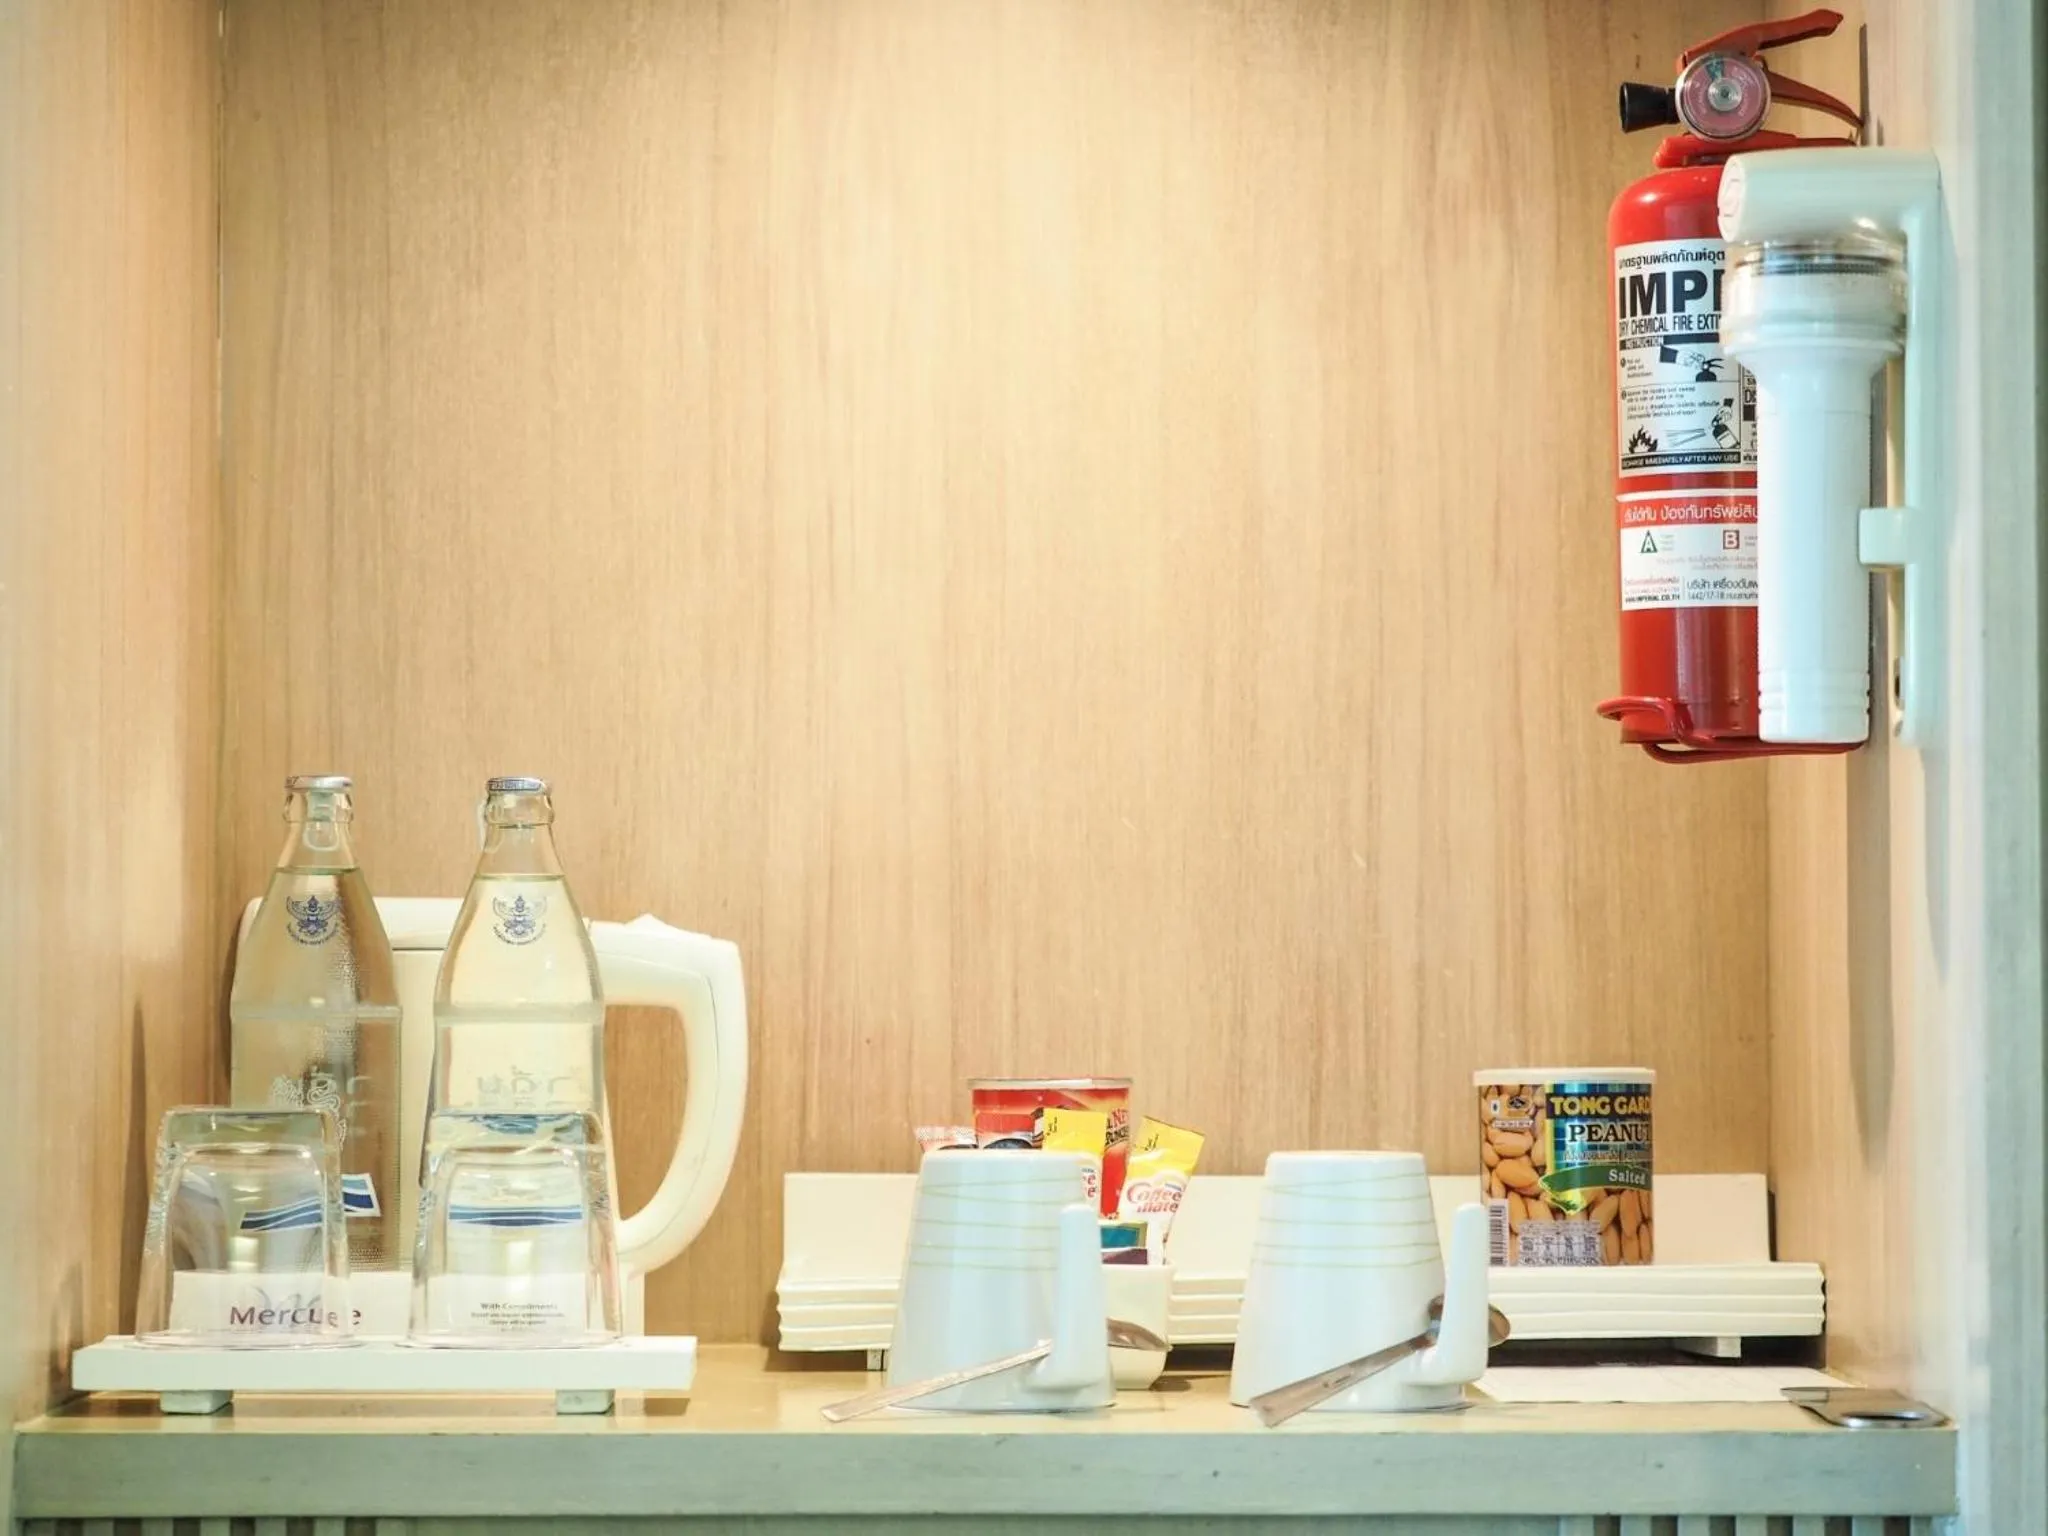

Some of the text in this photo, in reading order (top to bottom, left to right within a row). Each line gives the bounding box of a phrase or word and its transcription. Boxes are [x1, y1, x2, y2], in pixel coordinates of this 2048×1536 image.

[1631, 316, 1668, 335] CHEMICAL
[1673, 314, 1693, 331] FIRE
[1697, 313, 1722, 330] EXTI
[1684, 454, 1706, 463] AFTER
[1708, 453, 1721, 462] ANY
[1724, 531, 1739, 549] B
[1550, 1096, 1611, 1115] TONG
[1608, 1169, 1646, 1186] Salted
[1127, 1182, 1182, 1204] Coffee
